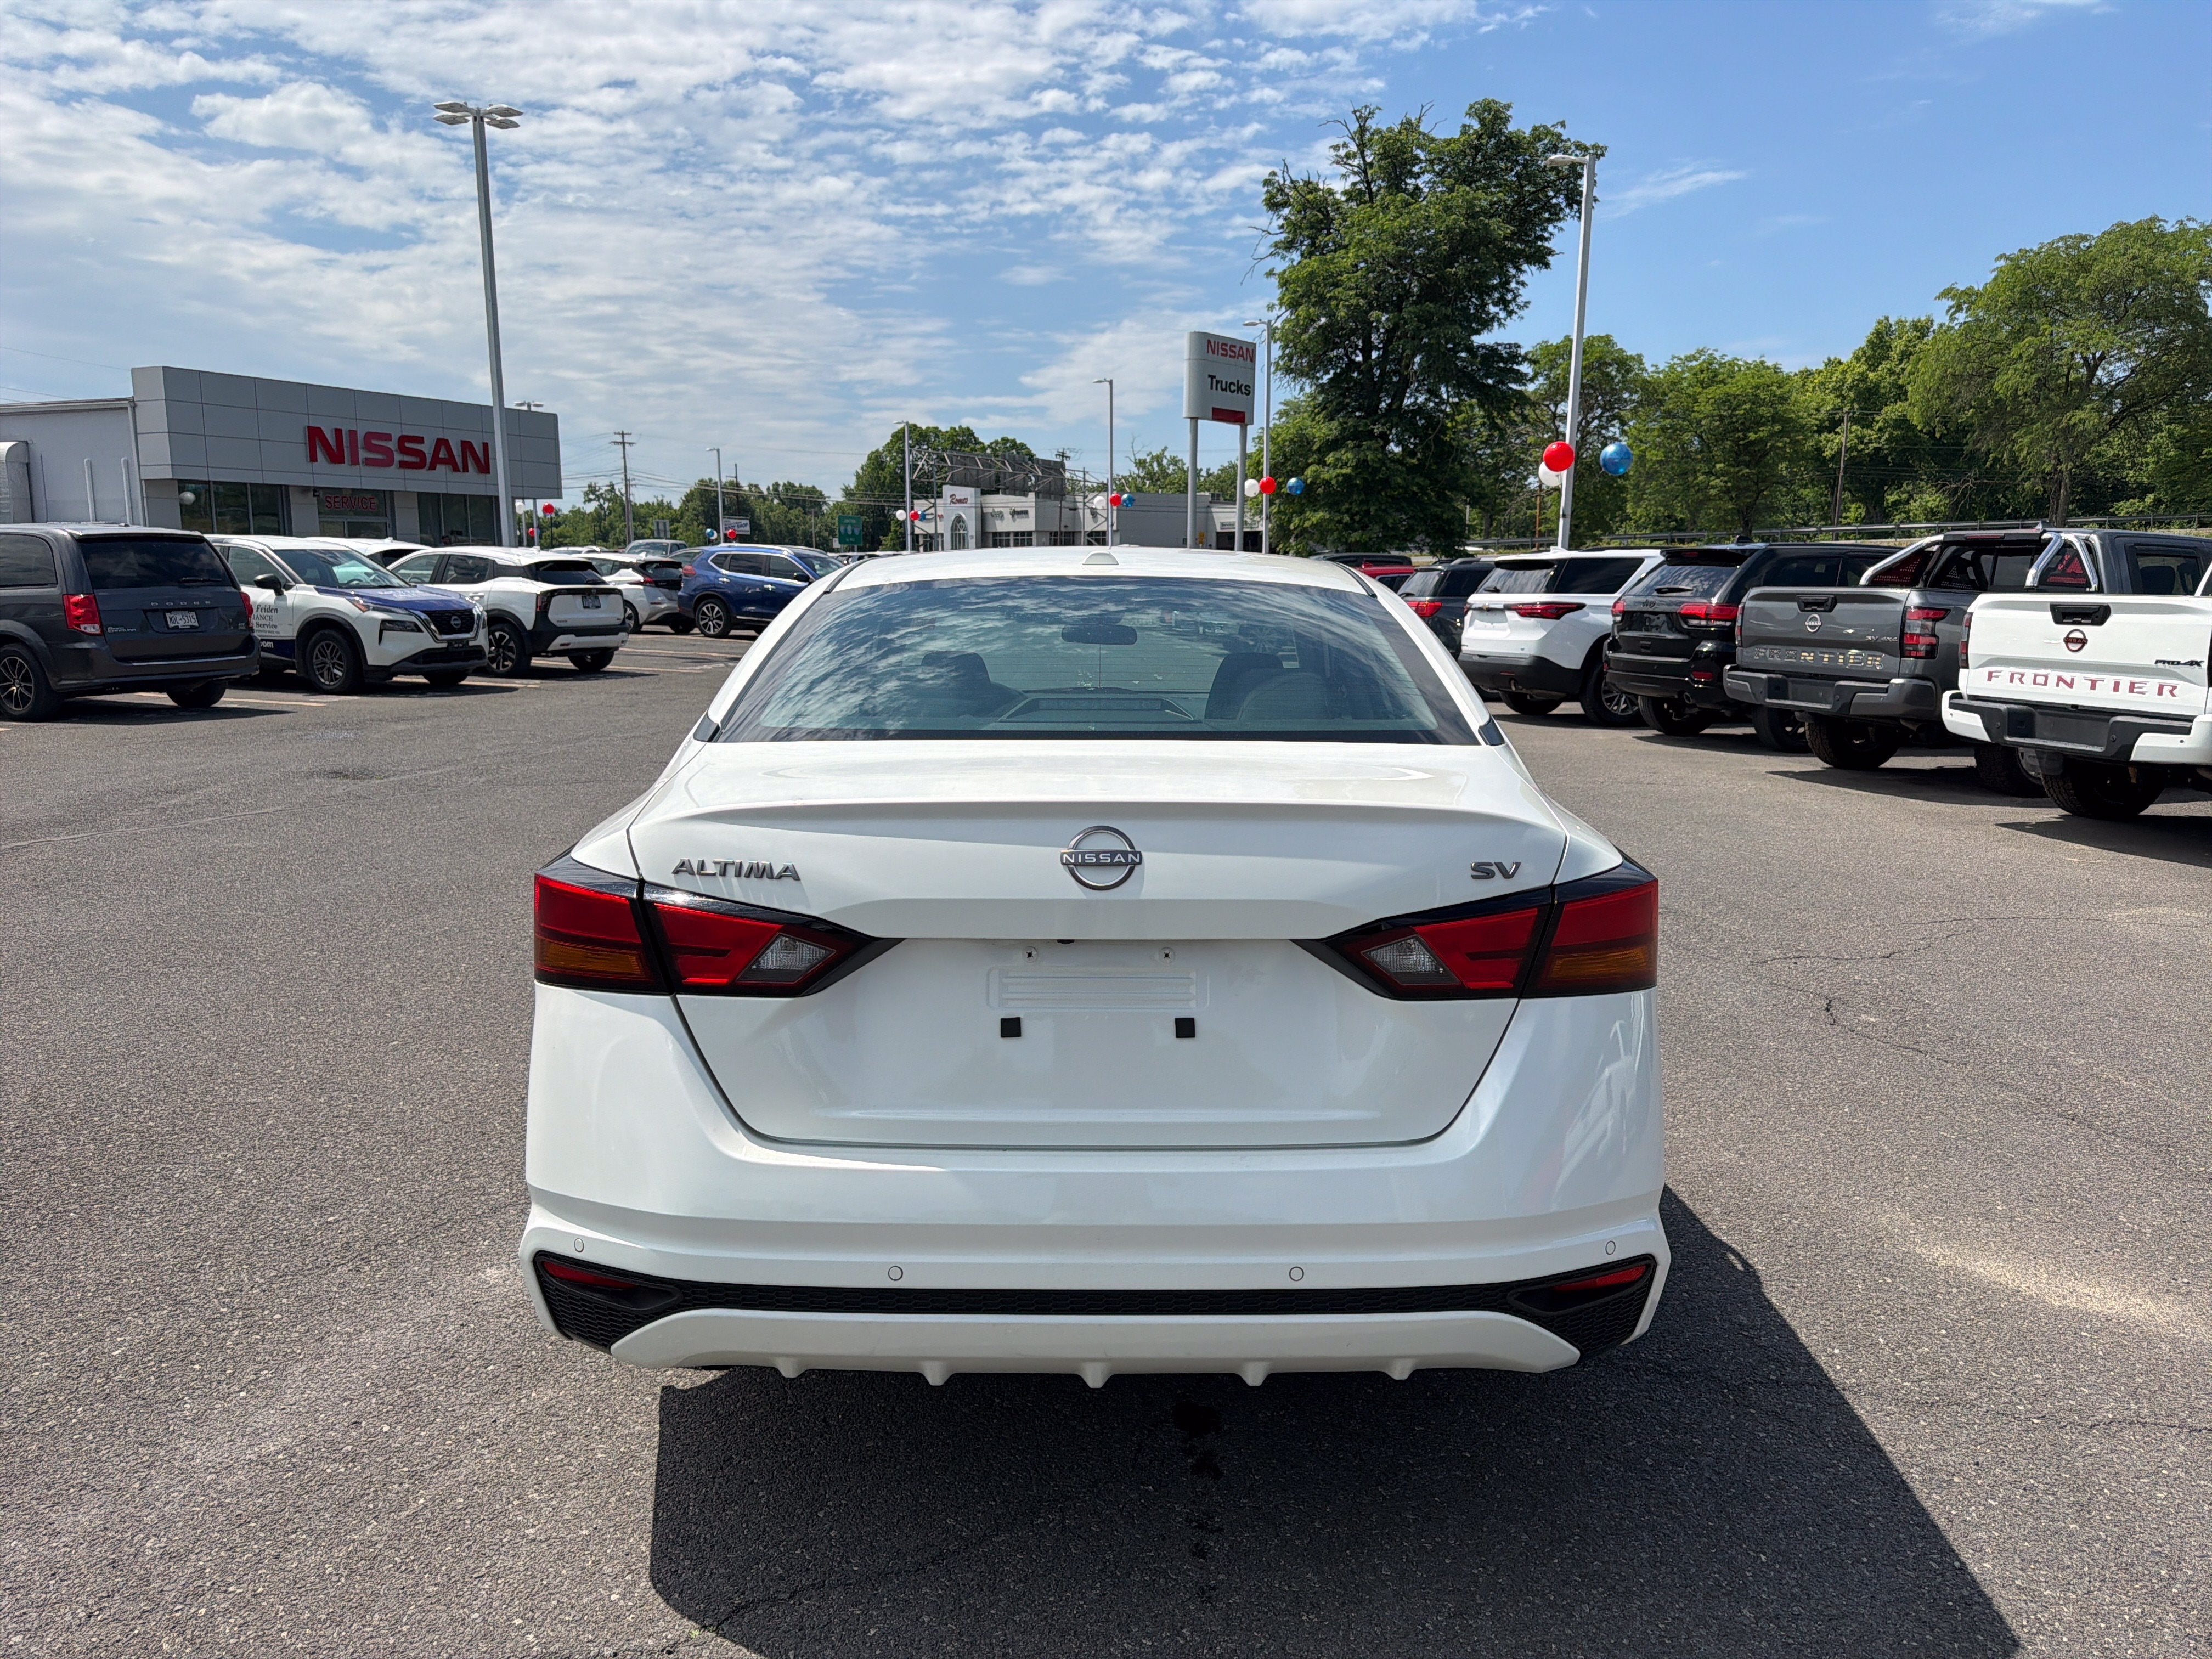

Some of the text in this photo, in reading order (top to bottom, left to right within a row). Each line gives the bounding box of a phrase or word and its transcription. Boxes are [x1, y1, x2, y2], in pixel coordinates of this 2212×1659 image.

[1206, 338, 1254, 363] NISSAN
[1207, 374, 1251, 396] Trucks
[307, 425, 491, 475] NISSAN
[325, 495, 377, 510] SERVICE
[256, 604, 278, 613] Feiden
[256, 621, 278, 629] Service
[1987, 669, 2180, 698] FRONTIER
[1063, 853, 1140, 863] NISSAN
[672, 857, 801, 881] ALTIMA
[1470, 861, 1522, 879] SV
